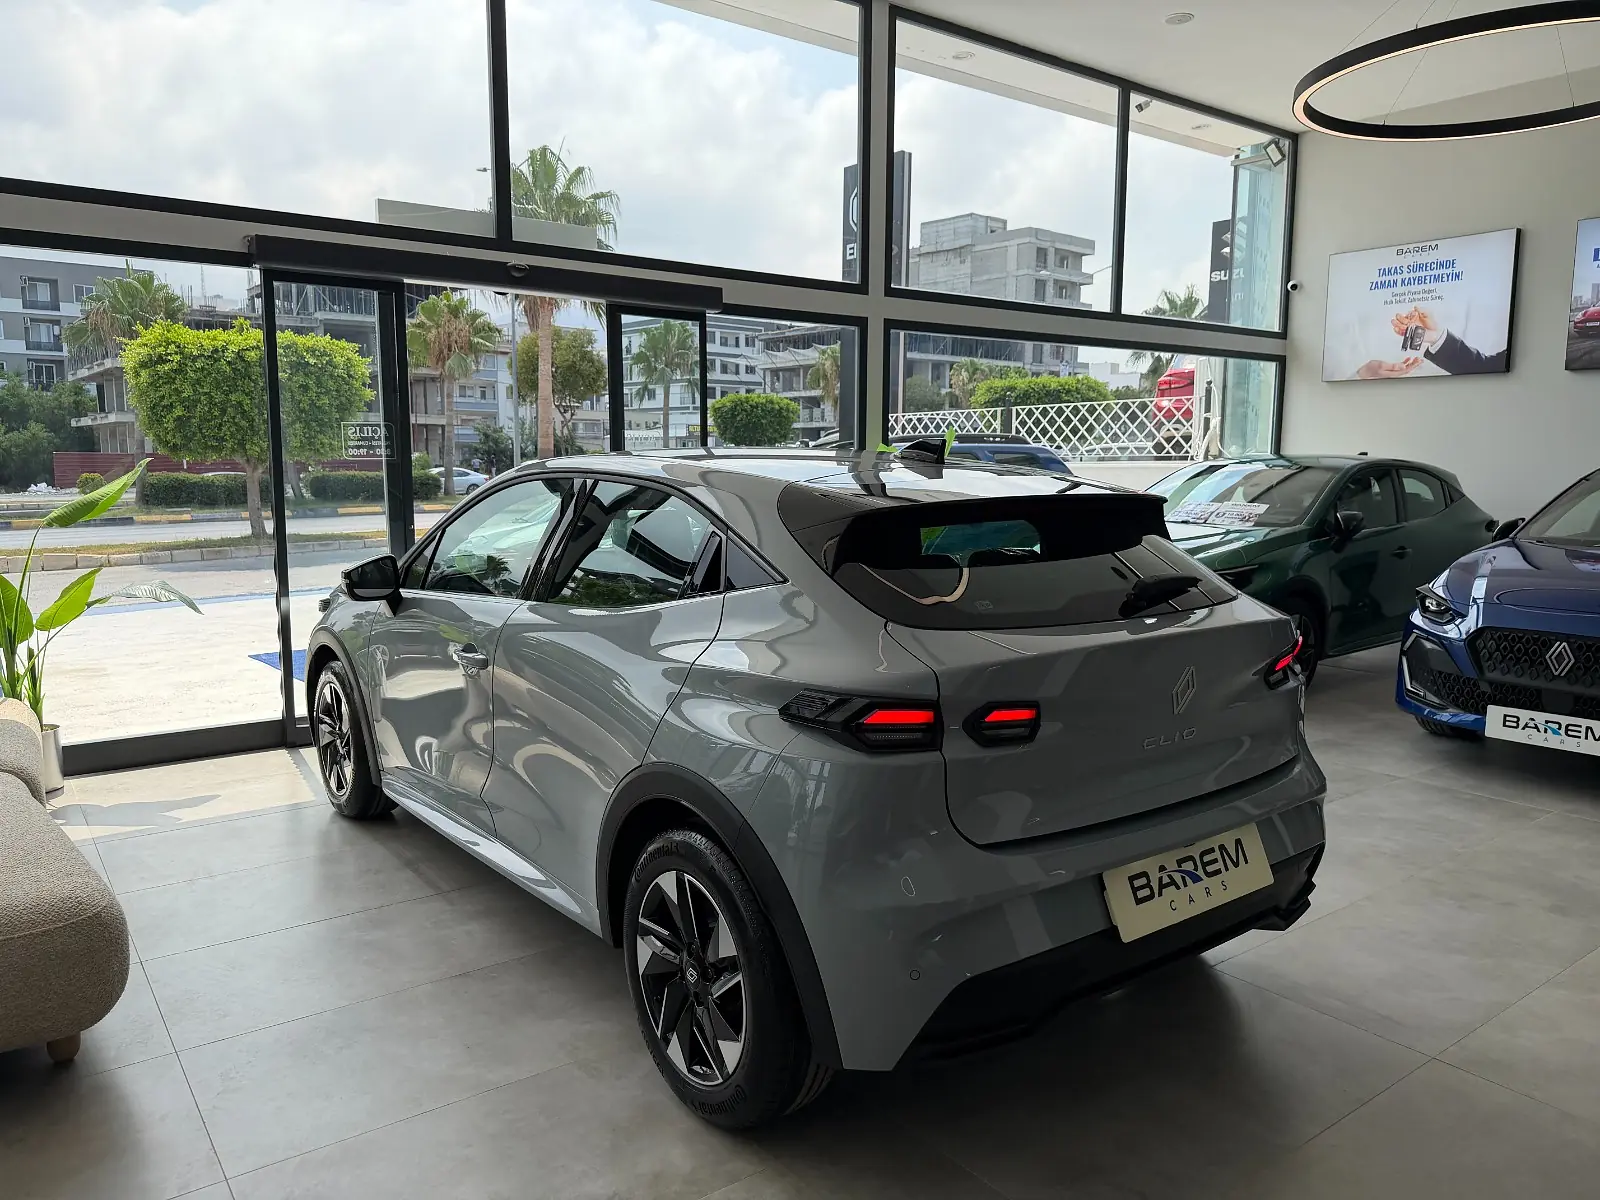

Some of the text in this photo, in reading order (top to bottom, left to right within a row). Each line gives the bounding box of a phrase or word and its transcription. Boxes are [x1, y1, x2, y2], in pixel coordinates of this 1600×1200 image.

[1396, 243, 1439, 256] BAREM
[1377, 258, 1457, 278] TAKAS SÜRECİNDE
[1369, 269, 1464, 291] ZAMAN KAYBETMEYİN!
[1143, 727, 1196, 749] CLIO
[1527, 733, 1581, 748] CARS
[1127, 837, 1249, 906] BAREM
[1169, 880, 1228, 912] CARS
